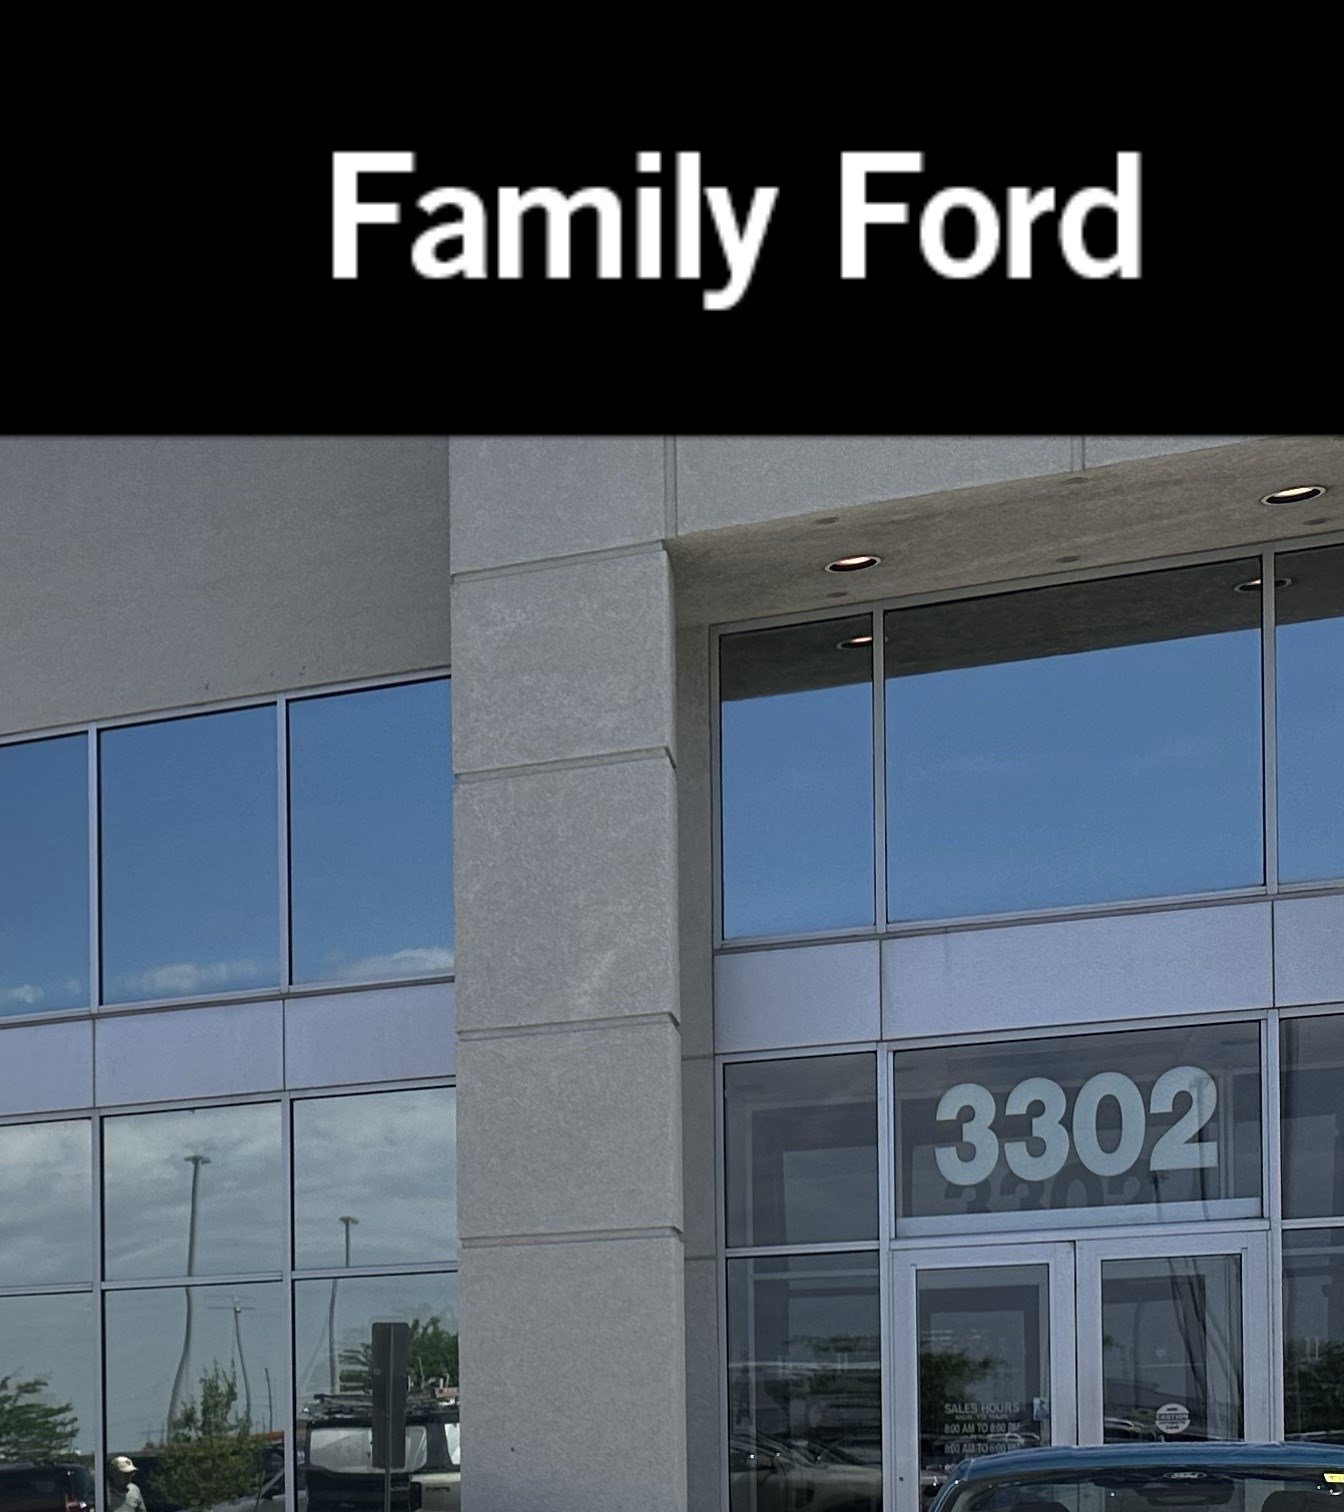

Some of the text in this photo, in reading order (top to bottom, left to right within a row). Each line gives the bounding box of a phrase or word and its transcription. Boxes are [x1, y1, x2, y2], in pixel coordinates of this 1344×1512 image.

[935, 1065, 1218, 1186] 3302
[944, 1401, 1021, 1414] SALES HOURS
[962, 1422, 975, 1434] AM
[977, 1422, 989, 1433] TO
